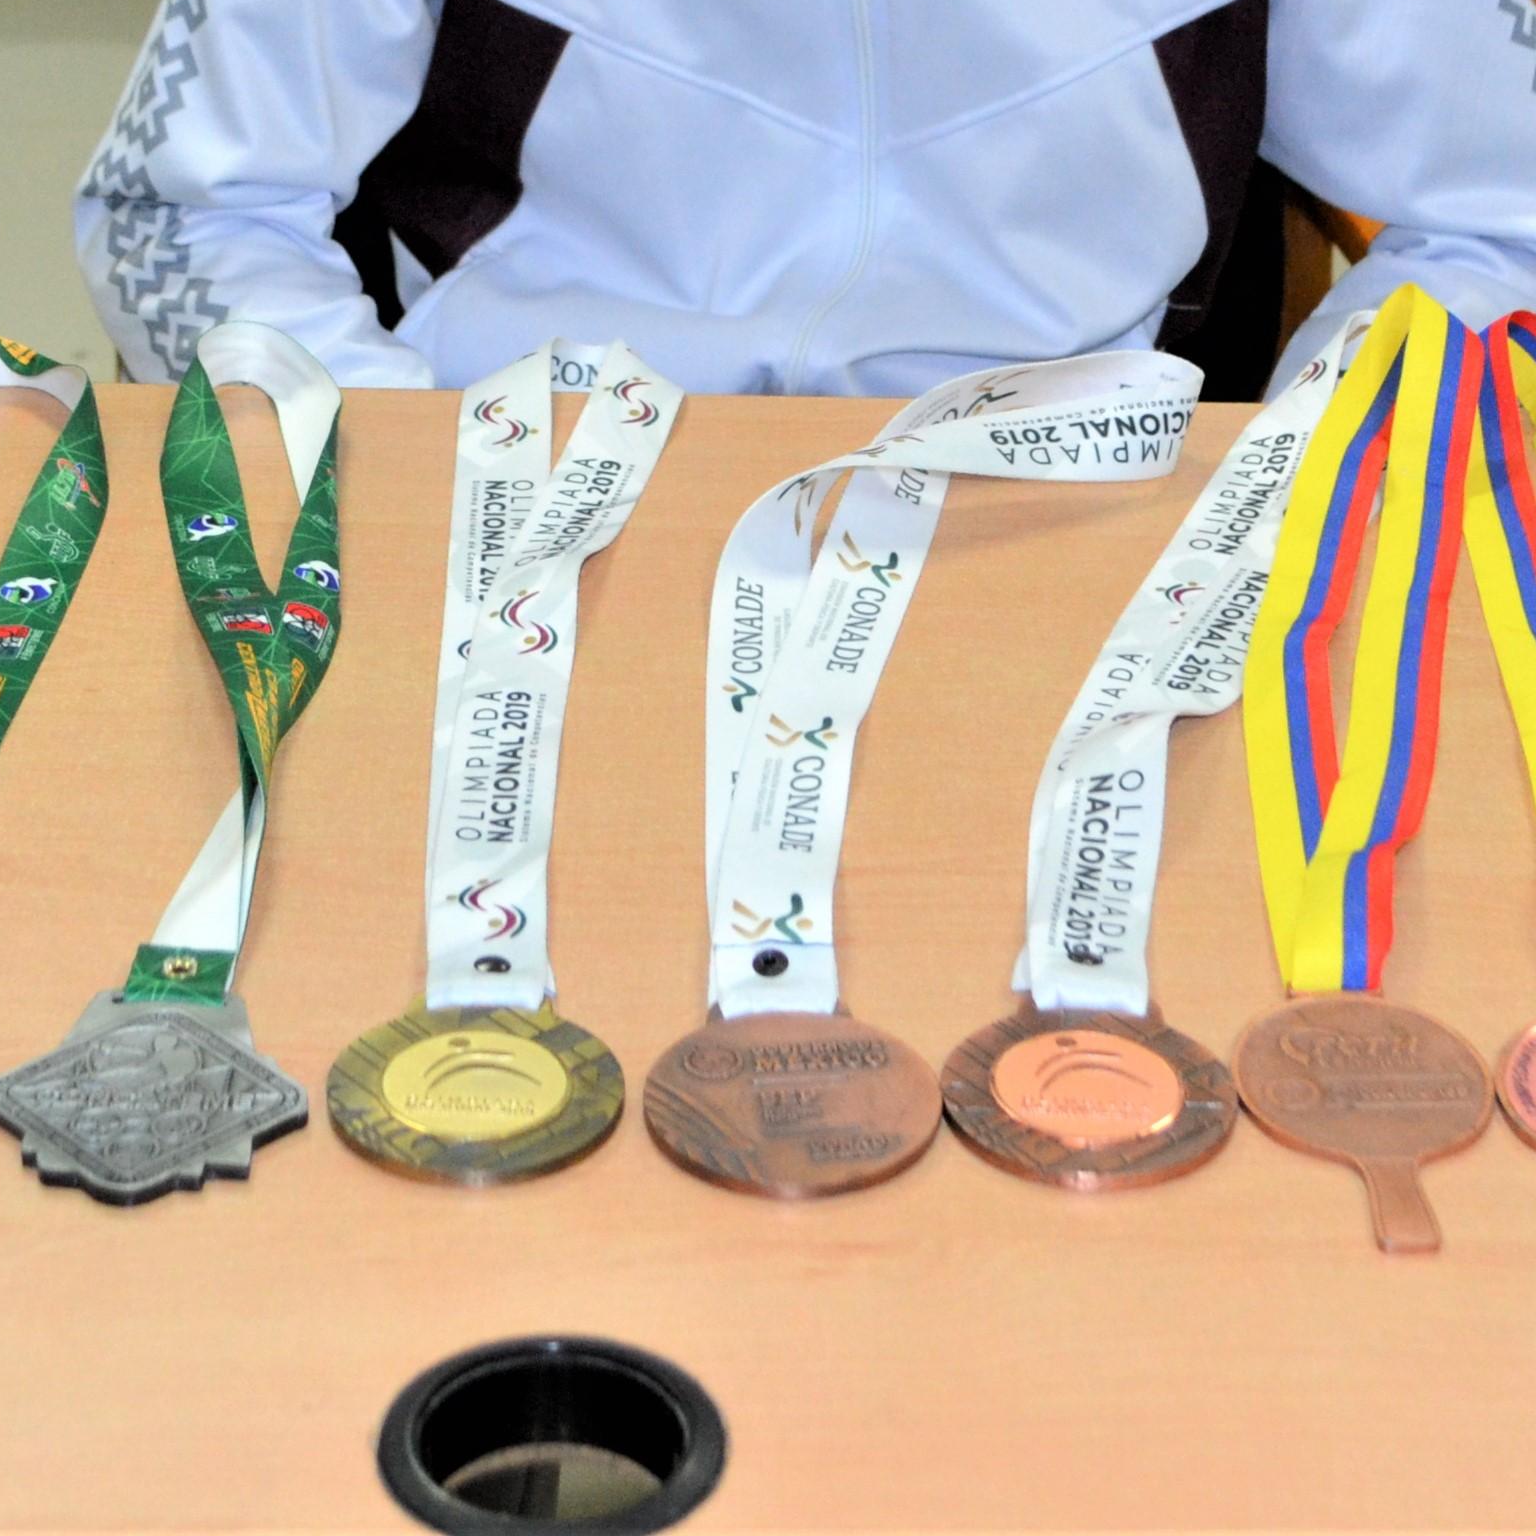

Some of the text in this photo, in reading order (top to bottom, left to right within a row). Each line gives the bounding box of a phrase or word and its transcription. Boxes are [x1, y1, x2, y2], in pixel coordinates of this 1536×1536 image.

[990, 425, 1062, 447] 2019
[996, 437, 1184, 465] IMPIADA
[481, 480, 508, 562] NACIONAL
[509, 480, 535, 540] OLIM
[514, 457, 597, 567] OLIMPIADA
[539, 460, 622, 561] NACIONAL 2019
[1189, 435, 1275, 551] OLIMPIADA
[1214, 432, 1296, 555] NACIONAL 2019
[731, 576, 764, 675] CONADE
[826, 586, 887, 674] CONADE
[1167, 570, 1270, 691] NACIONAL 2019
[456, 691, 502, 841] OLIMPIADA
[486, 691, 532, 842] NACIONAL 2019
[525, 763, 536, 805] Nacional
[779, 755, 825, 852] CONADE
[1071, 773, 1115, 902] NACIONAL
[1096, 769, 1144, 956] OLIMPIADA
